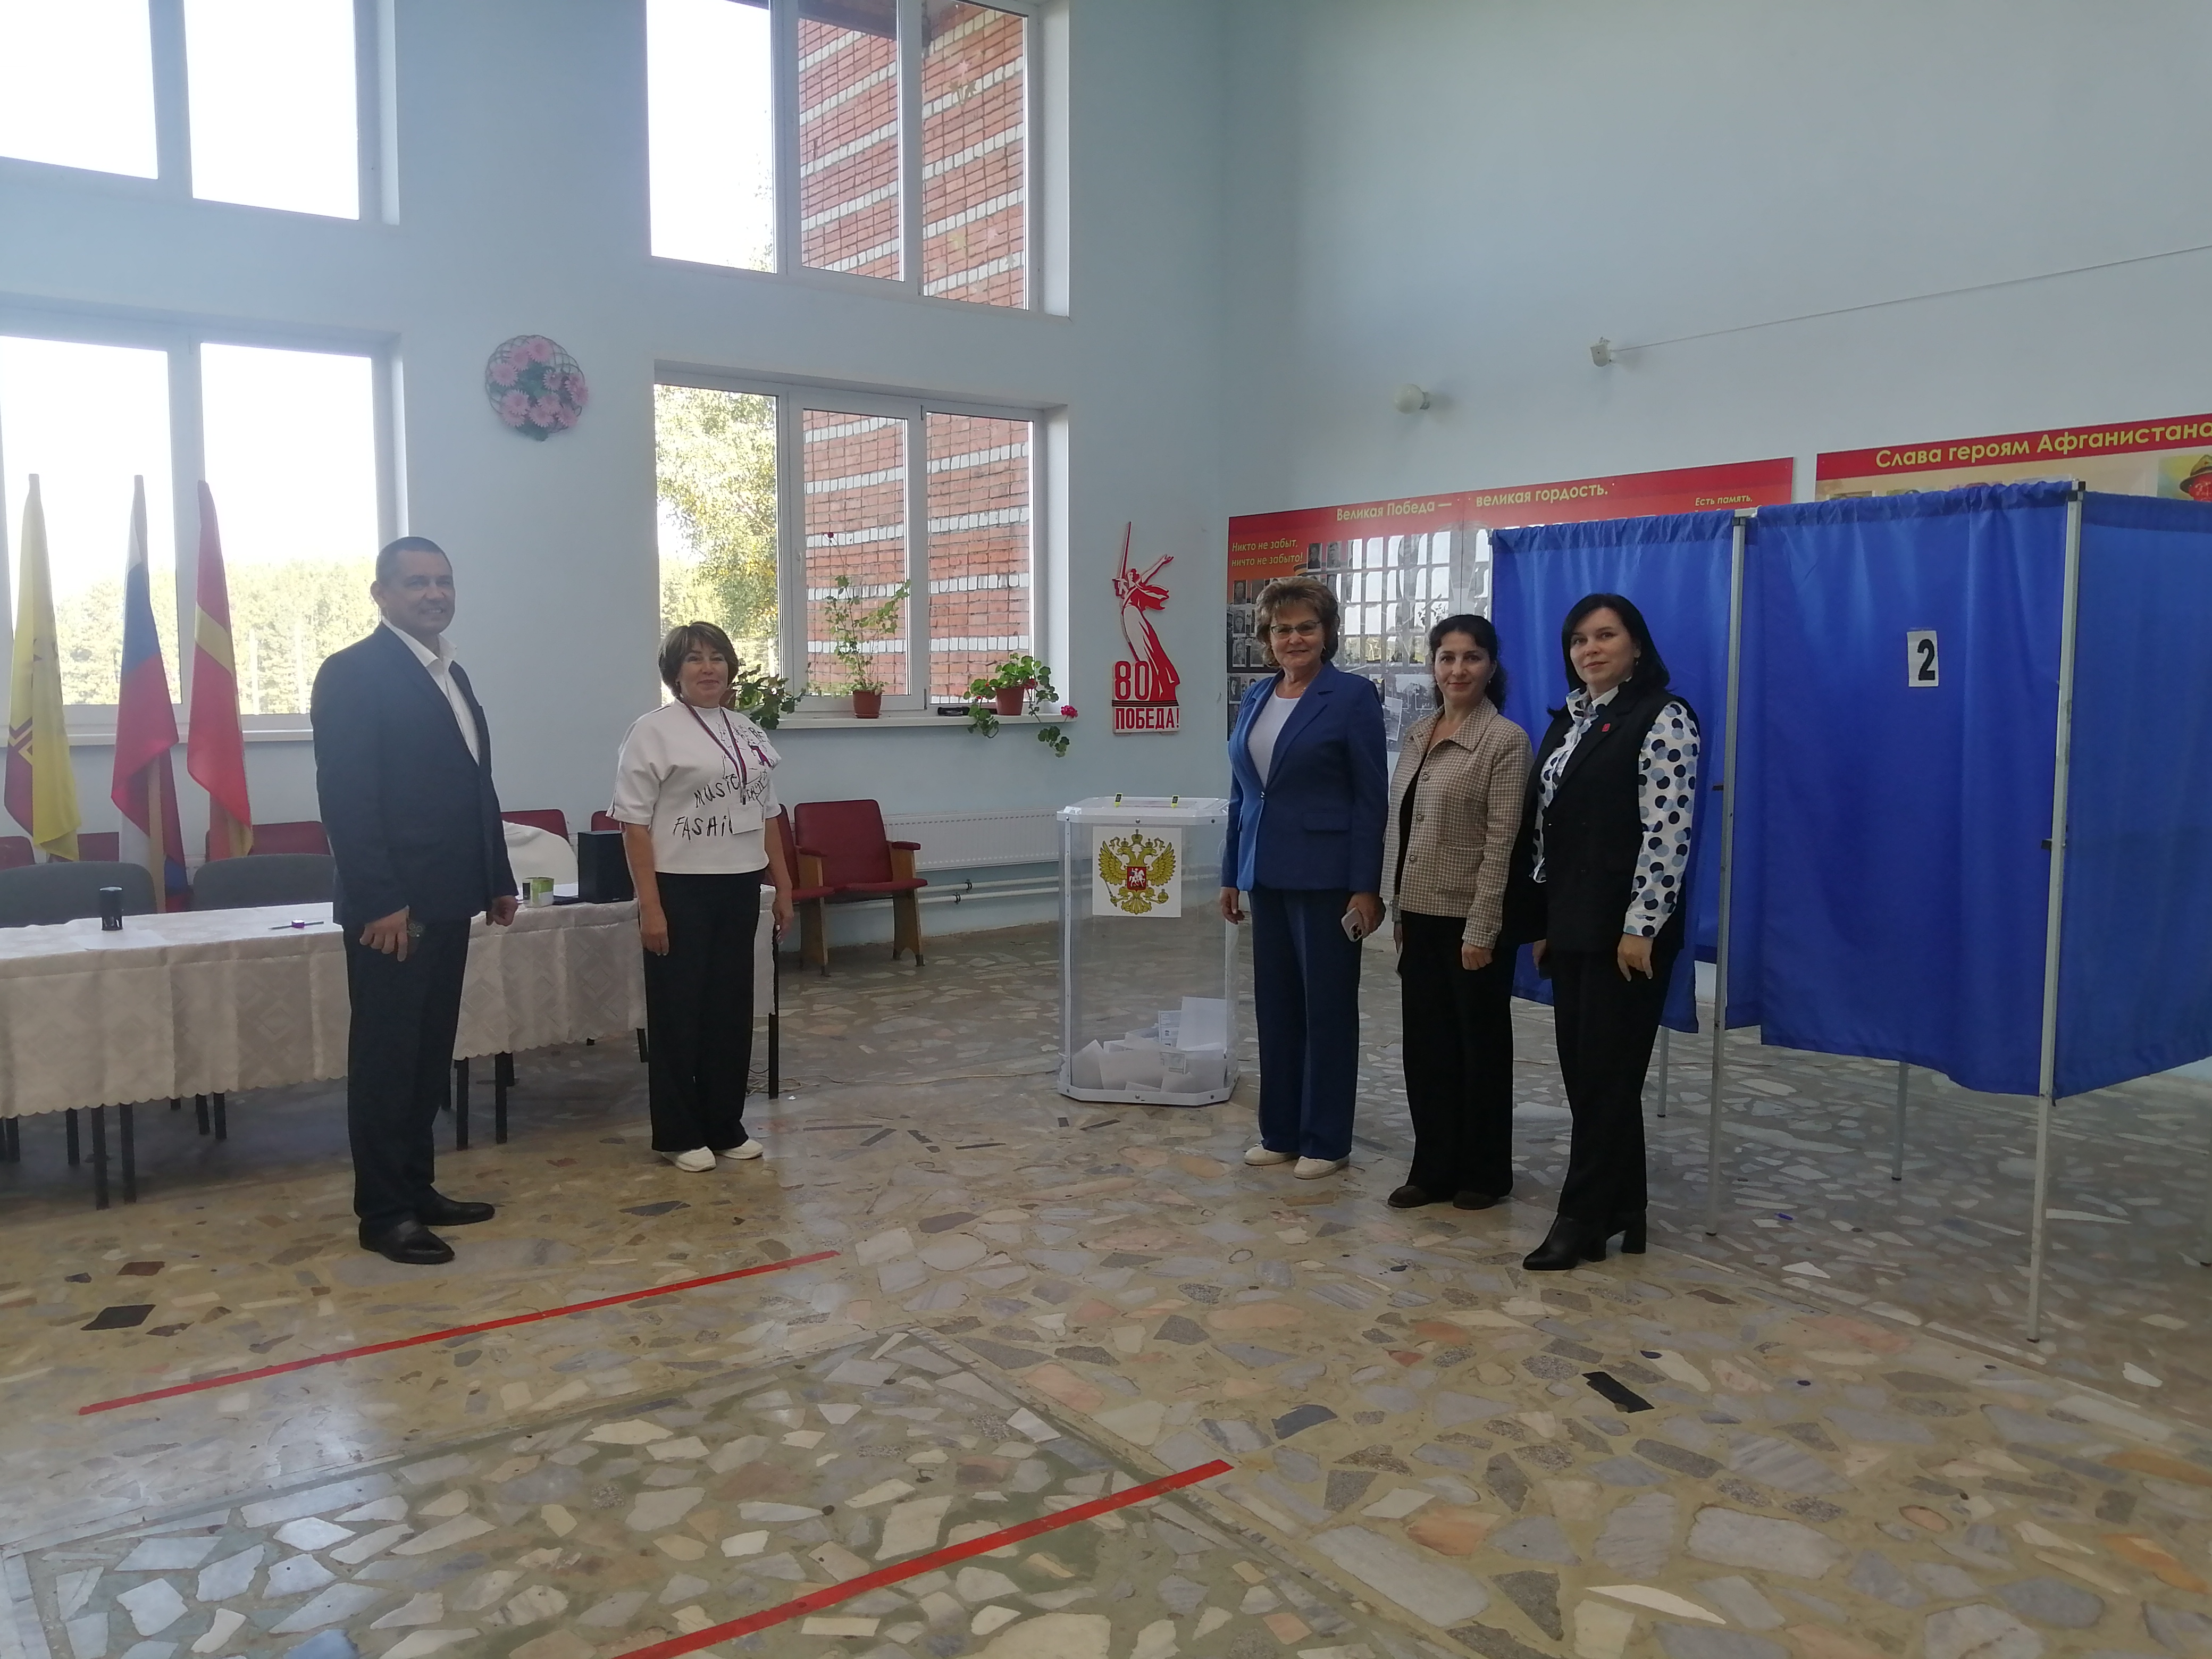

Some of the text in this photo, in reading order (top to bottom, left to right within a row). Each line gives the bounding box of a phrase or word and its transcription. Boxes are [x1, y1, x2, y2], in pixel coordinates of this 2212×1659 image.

[1876, 448, 1942, 468] Слава
[1948, 439, 2030, 463] героям
[1336, 507, 1384, 521] Великая
[1387, 501, 1435, 517] Победа
[1476, 491, 1531, 507] великая
[1535, 484, 1608, 504] гордость.
[1695, 497, 1715, 506] Есть
[1231, 551, 1303, 567] ничто не забыто!
[1232, 541, 1256, 552] Никто
[1258, 541, 1268, 550] не
[1917, 639, 1935, 681] 2
[1115, 661, 1149, 700] 80
[1116, 708, 1179, 730] ПОБЕДА!
